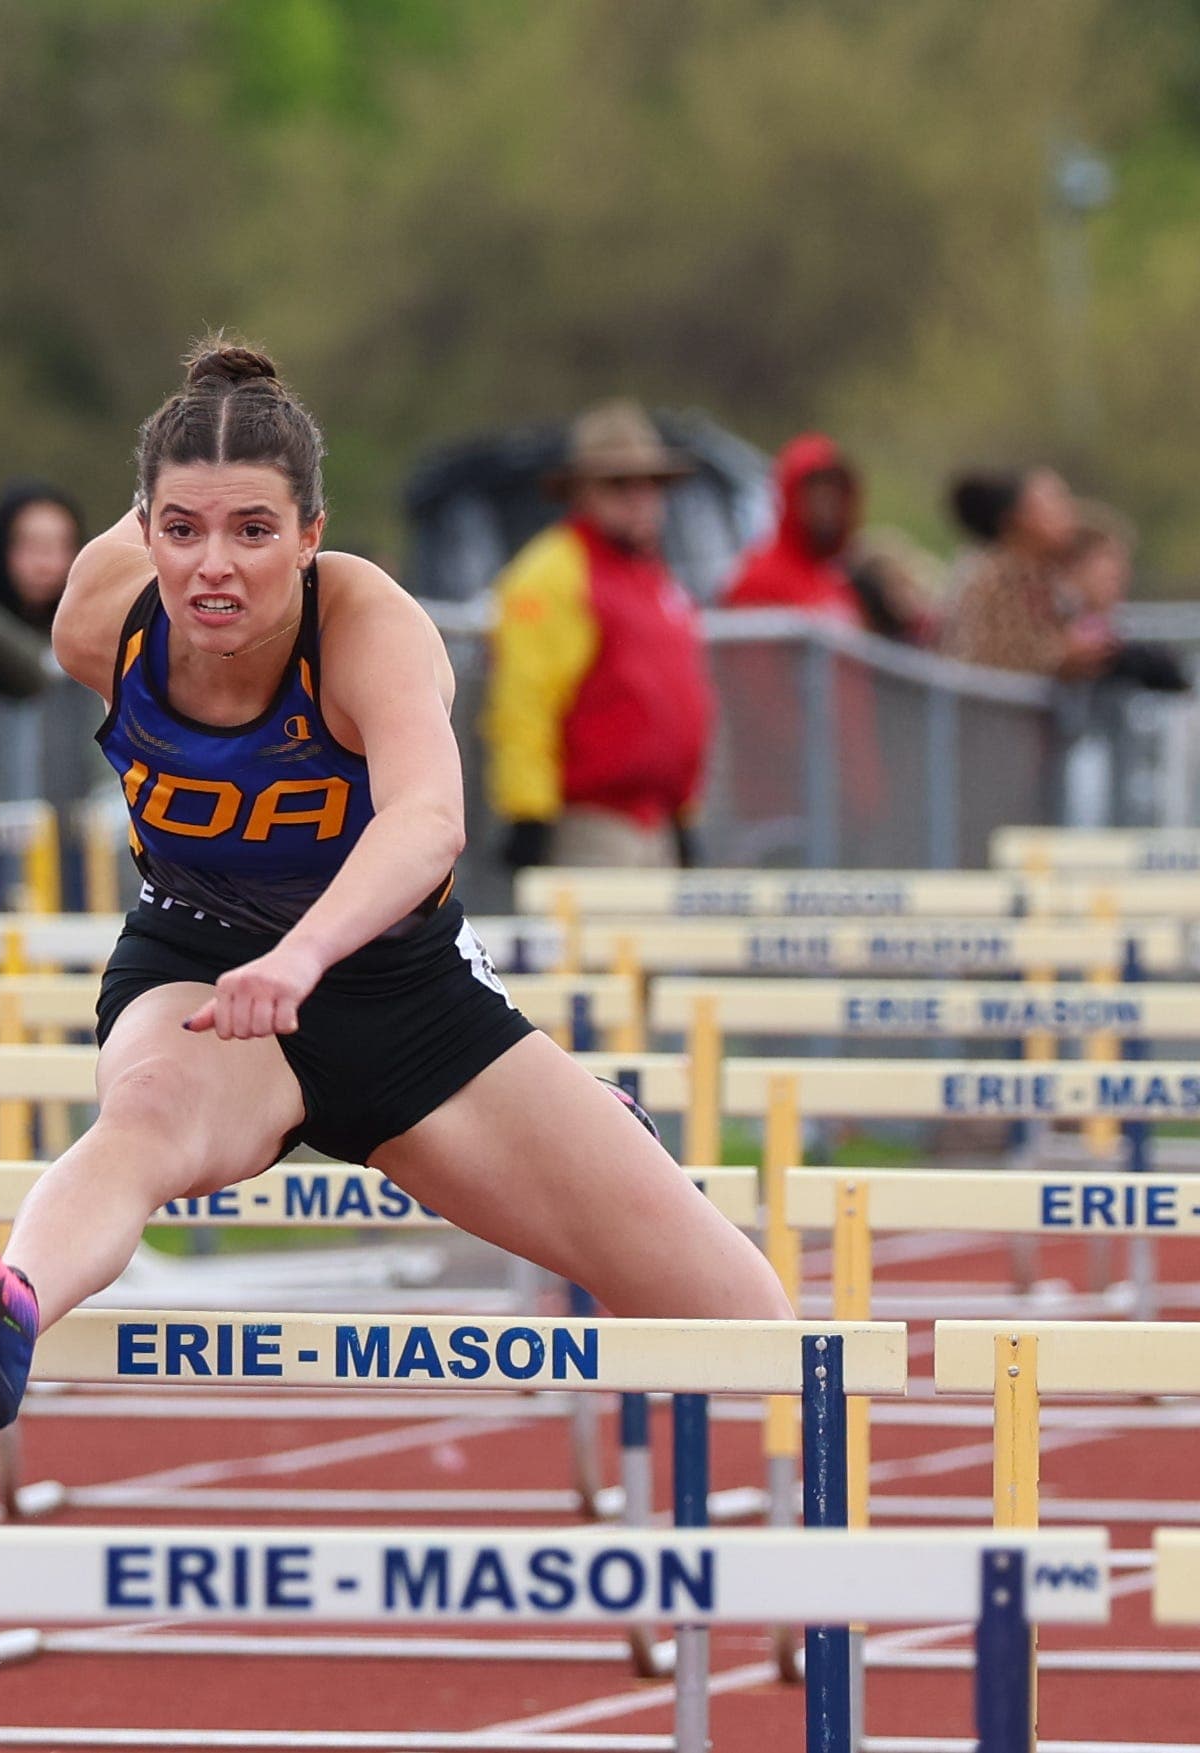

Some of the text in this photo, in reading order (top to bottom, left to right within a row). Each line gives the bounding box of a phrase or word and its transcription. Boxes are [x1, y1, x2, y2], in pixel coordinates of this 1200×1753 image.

[942, 1075, 1055, 1108] ERIE
[1099, 1075, 1200, 1109] MAS
[285, 1176, 441, 1218] MAS
[1041, 1185, 1177, 1227] ERIE
[117, 1323, 283, 1377] ERIE
[335, 1325, 598, 1380] MASON
[105, 1546, 313, 1609] ERIE
[382, 1547, 715, 1613] MASON
